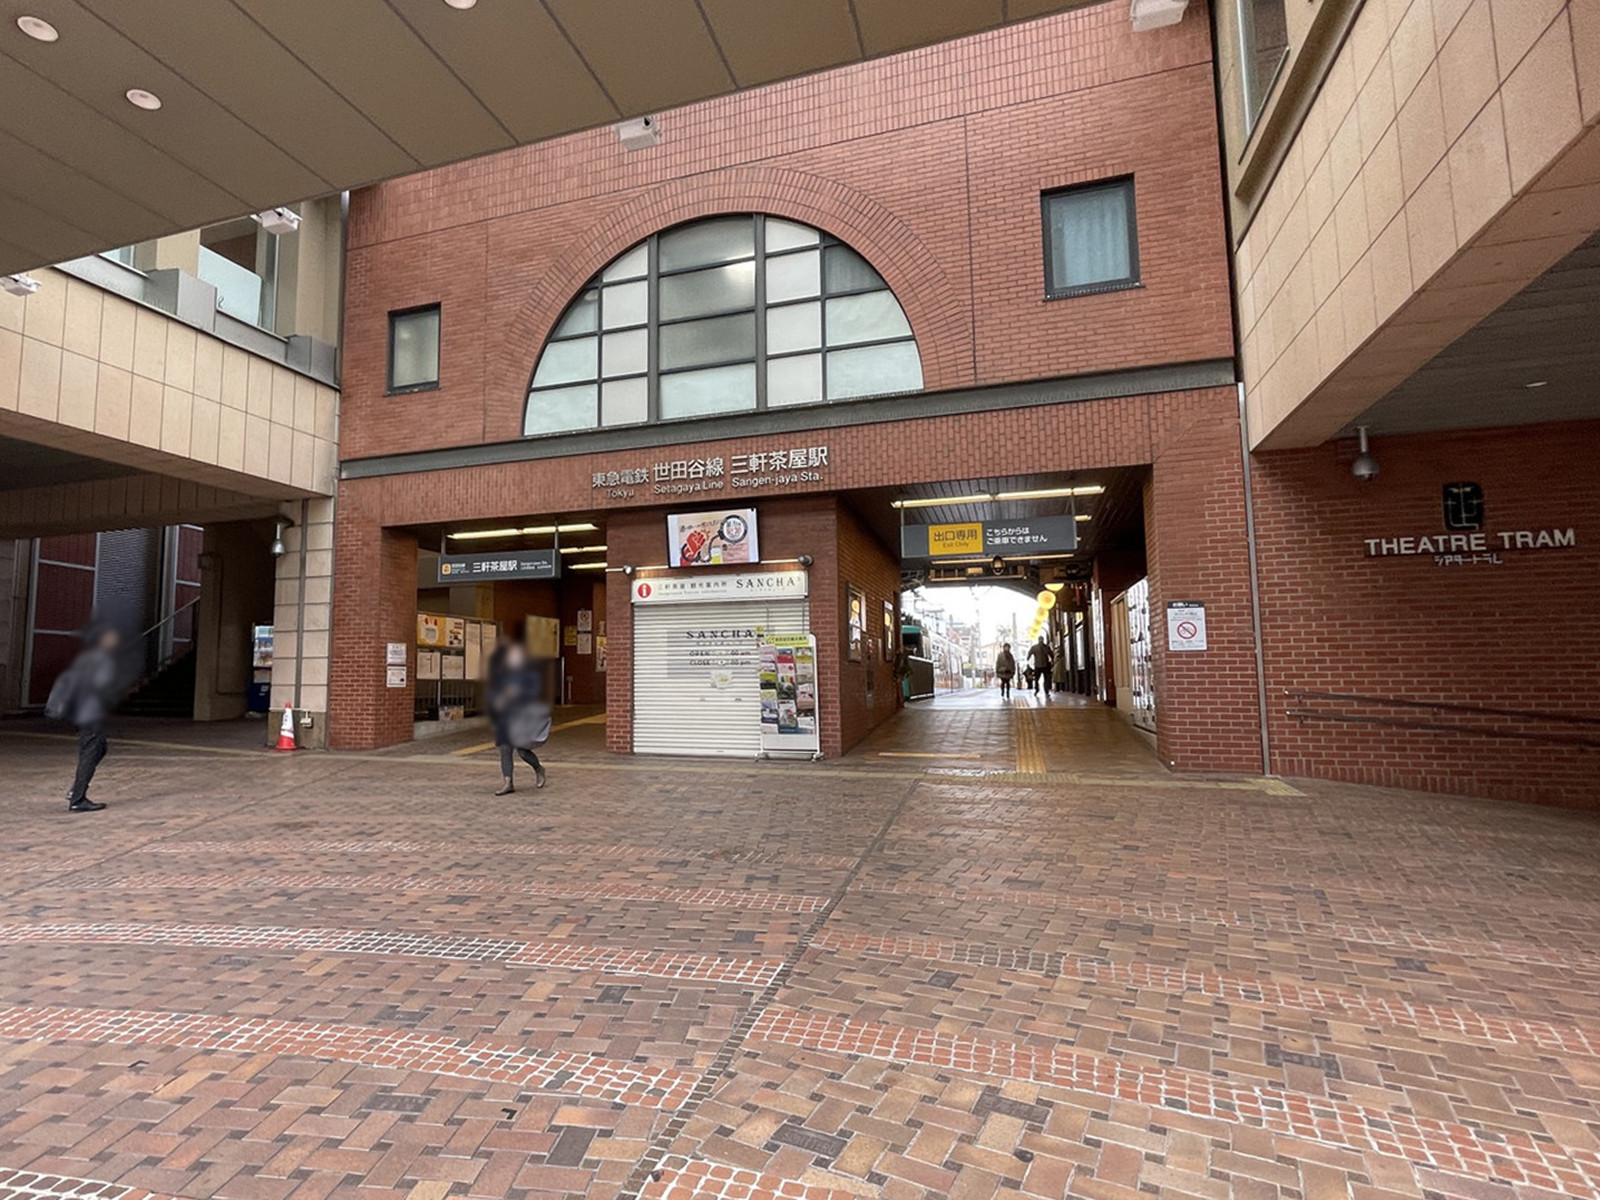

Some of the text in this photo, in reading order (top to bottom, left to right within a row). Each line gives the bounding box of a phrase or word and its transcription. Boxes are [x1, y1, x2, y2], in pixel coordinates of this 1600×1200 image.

[592, 446, 828, 488] 東急電鉄 世田谷線 三軒茶屋駅
[606, 471, 824, 499] Tokyu Setagaya Line Sangen-jaya Sta.
[934, 529, 978, 542] 出口専用
[986, 527, 1030, 537] こちらからは
[1364, 528, 1576, 555] THEATRE TRAM
[473, 560, 518, 573] 三軒茶屋駅
[736, 576, 796, 589] SANCHA
[686, 629, 754, 640] SANCHA
